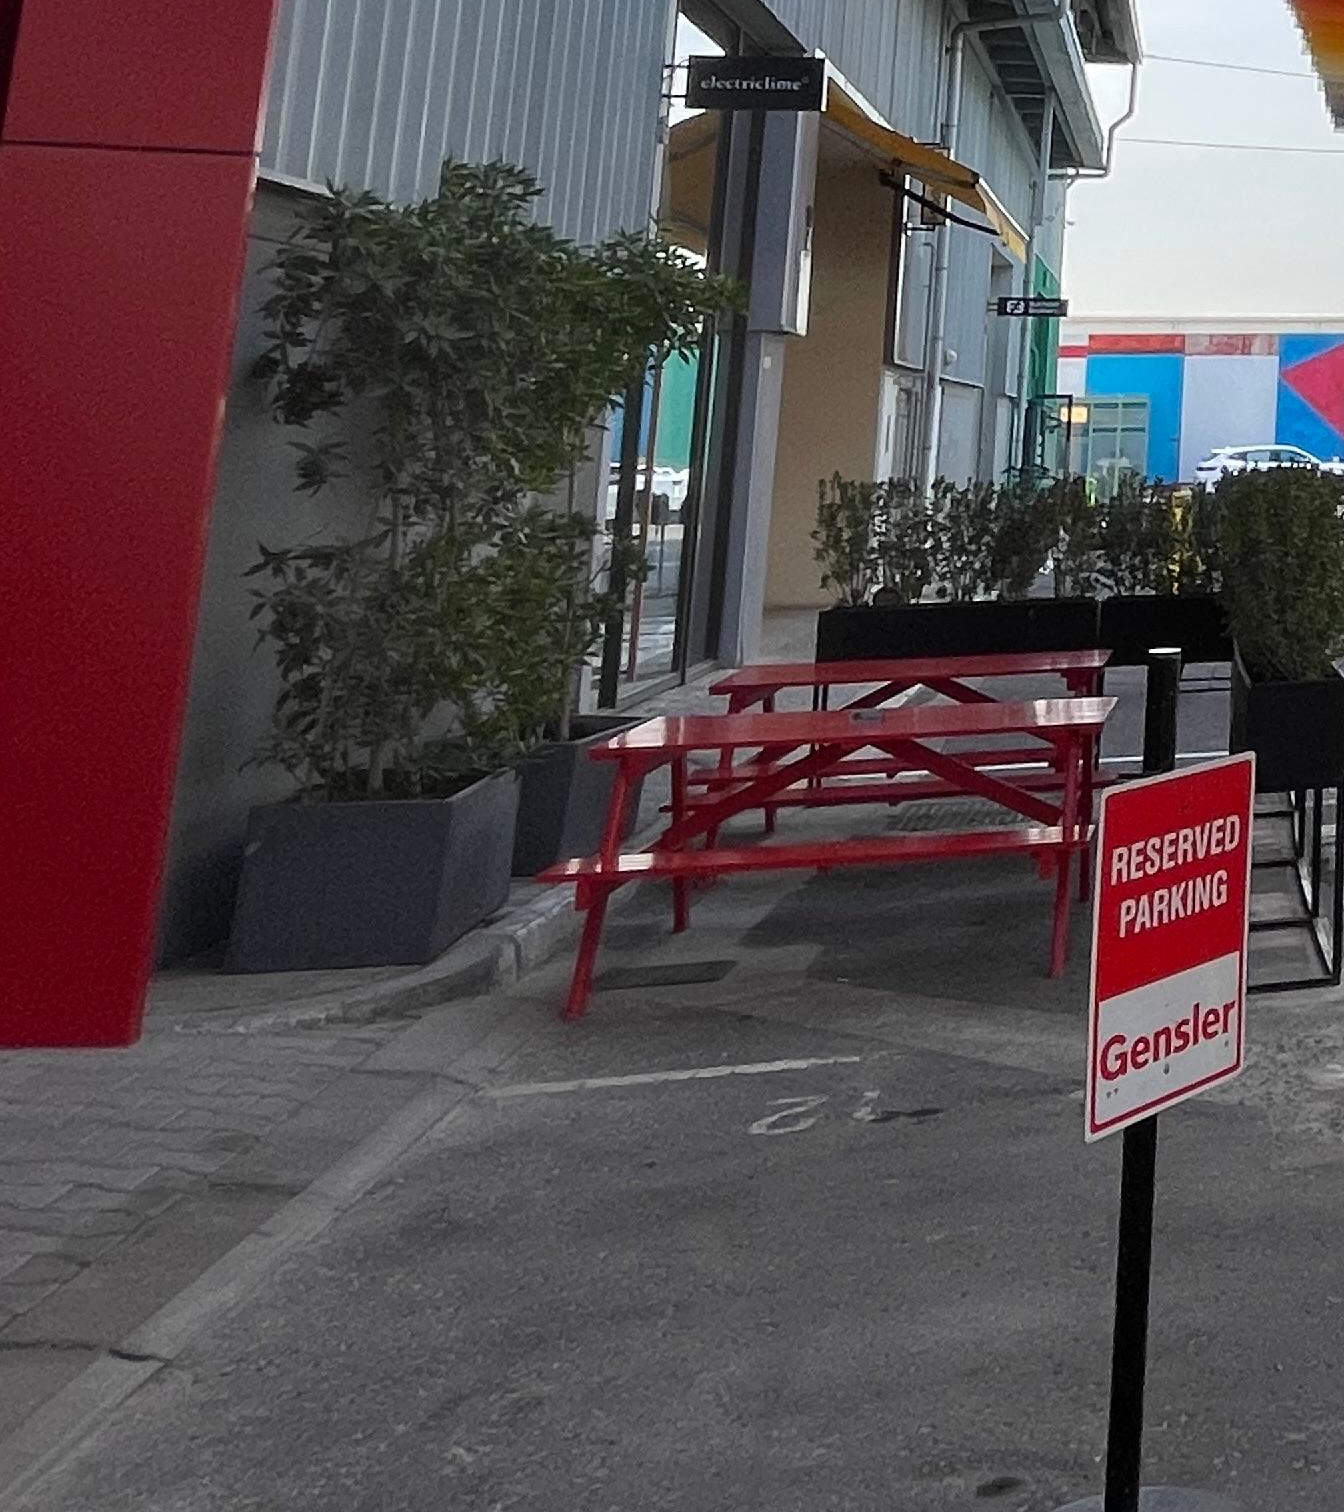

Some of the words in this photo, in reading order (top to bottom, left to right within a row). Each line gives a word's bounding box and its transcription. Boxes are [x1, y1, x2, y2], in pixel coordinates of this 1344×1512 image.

[1110, 814, 1240, 886] RESERVED
[1119, 869, 1228, 938] PARKING
[1100, 1001, 1237, 1081] Gensler
